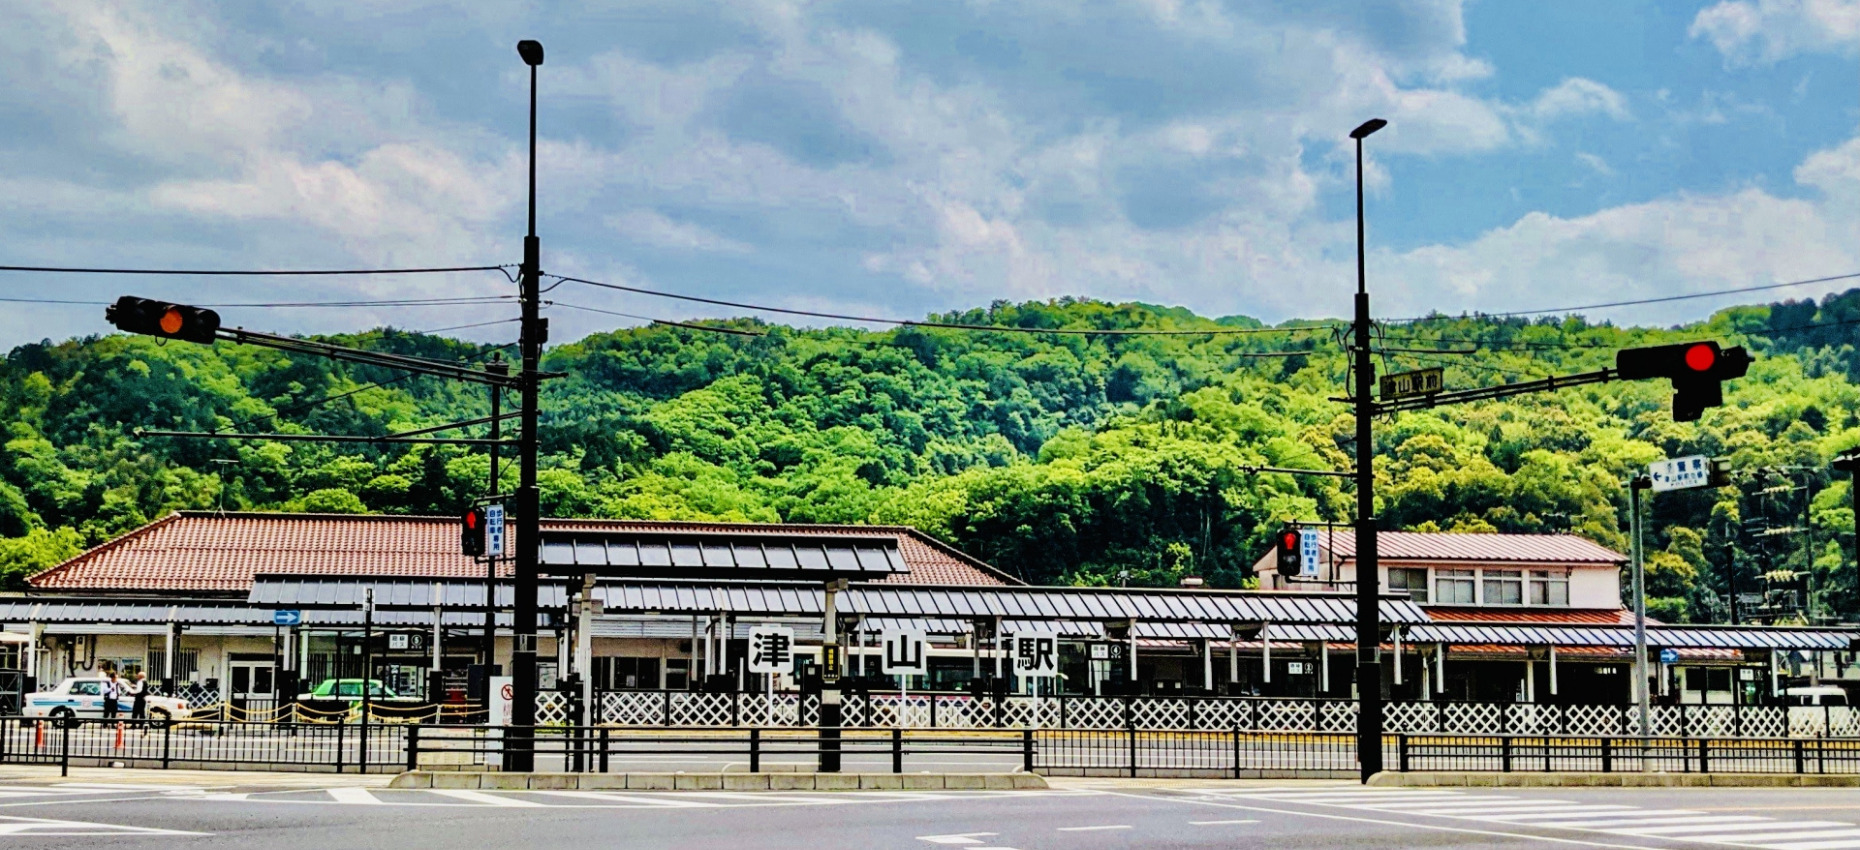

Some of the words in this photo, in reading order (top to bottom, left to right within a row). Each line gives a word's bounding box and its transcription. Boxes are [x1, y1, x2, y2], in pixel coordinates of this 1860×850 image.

[753, 633, 790, 667] 津
[887, 635, 921, 669] 山
[1017, 637, 1054, 671] 駅
